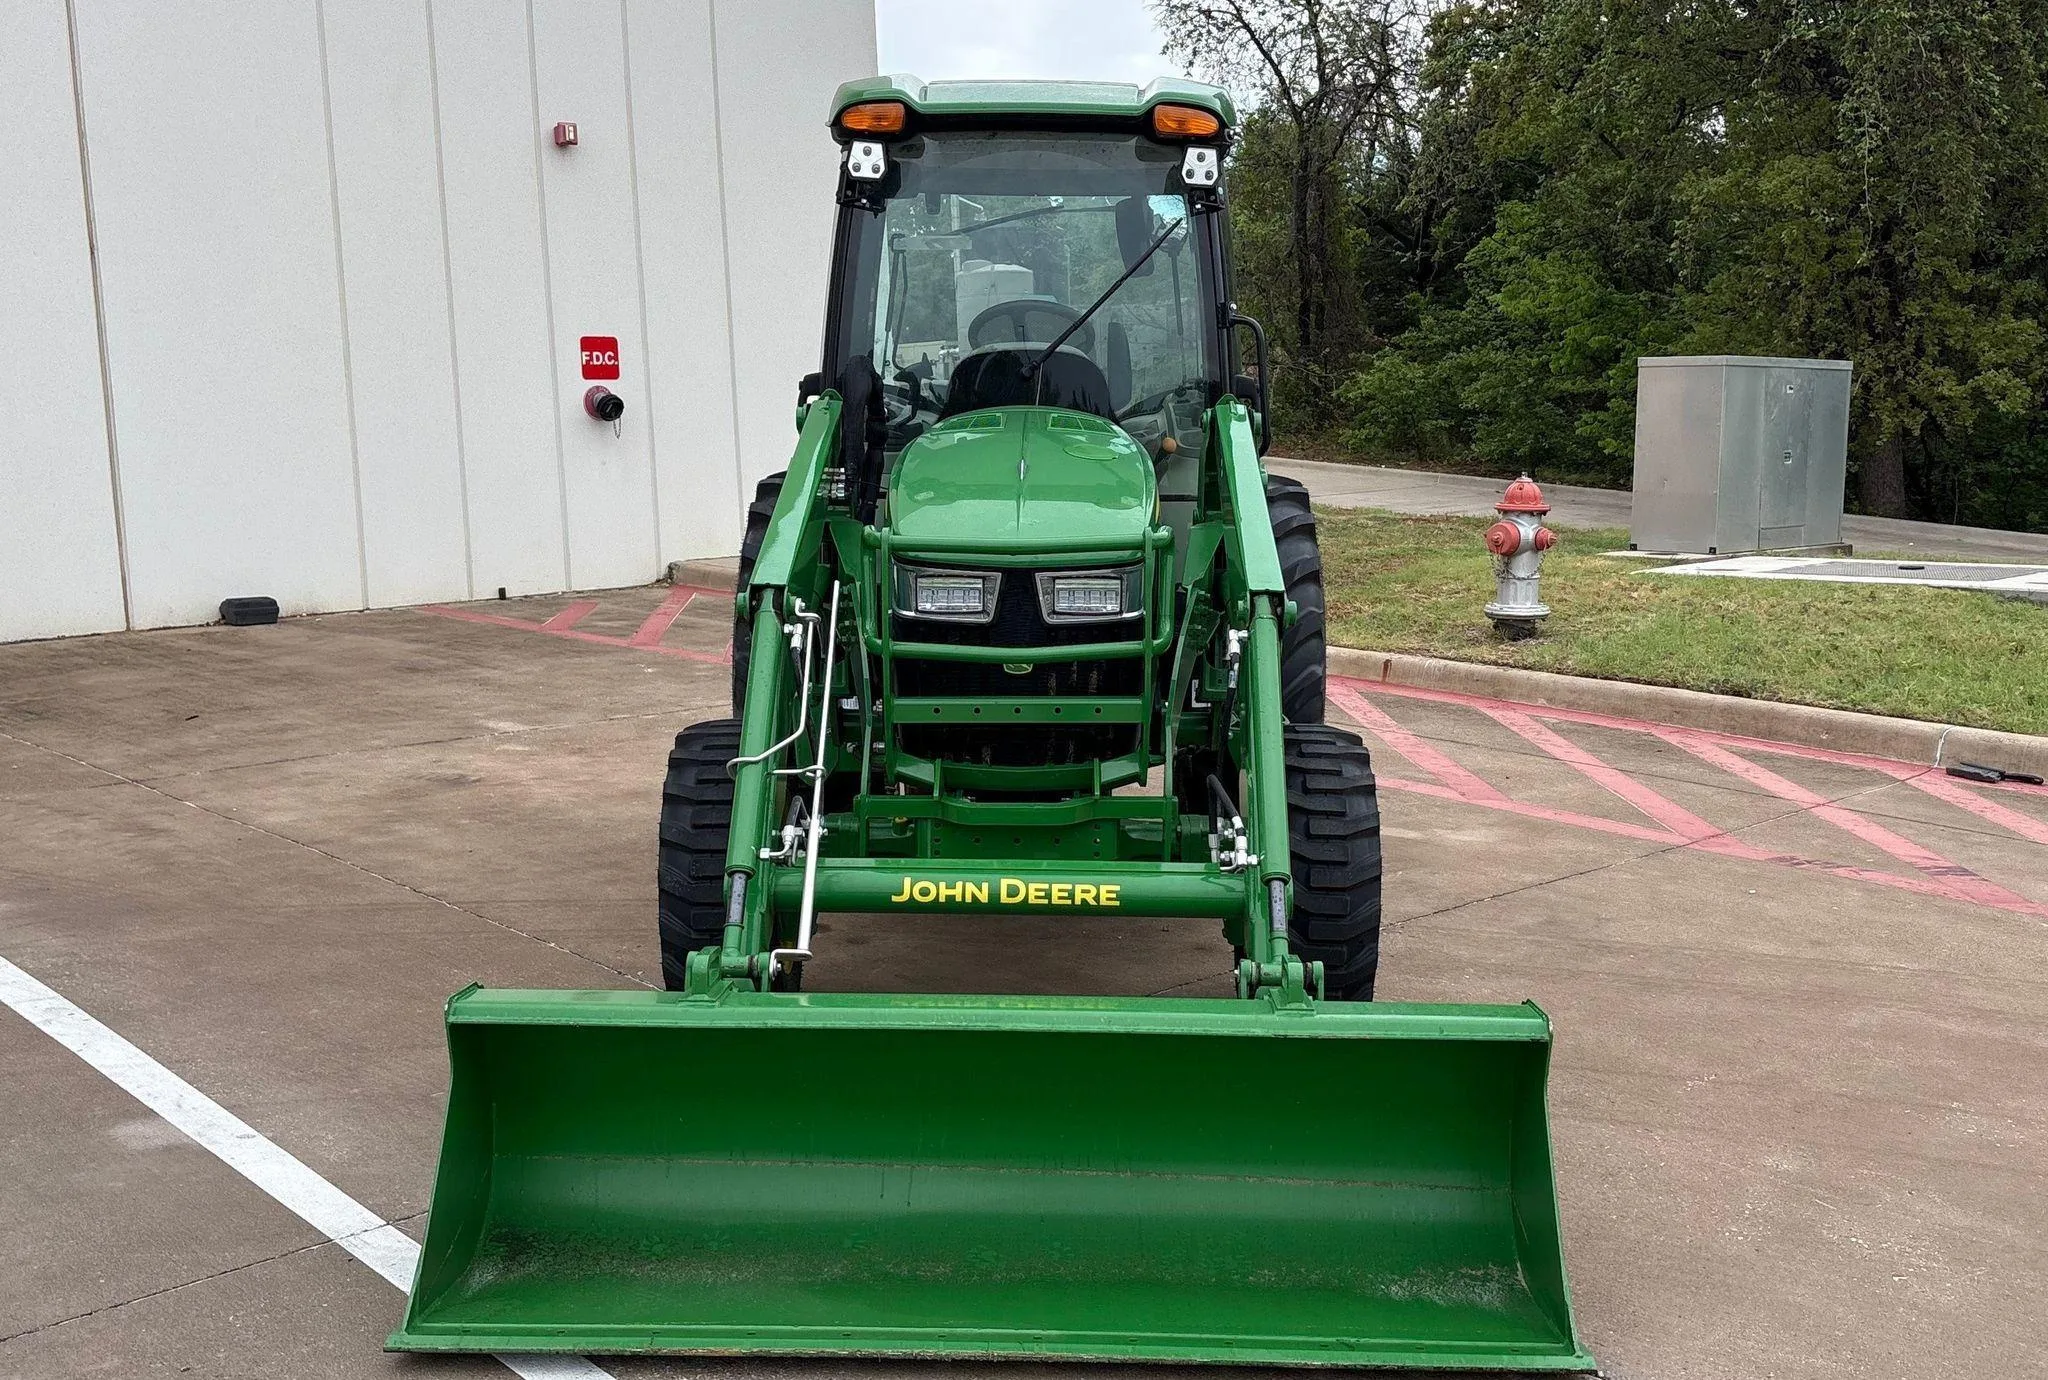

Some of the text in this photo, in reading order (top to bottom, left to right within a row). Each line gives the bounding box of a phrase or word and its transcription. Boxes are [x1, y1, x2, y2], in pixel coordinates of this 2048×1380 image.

[582, 351, 618, 366] F.D.C.
[891, 876, 1121, 907] JOHN DEERE
